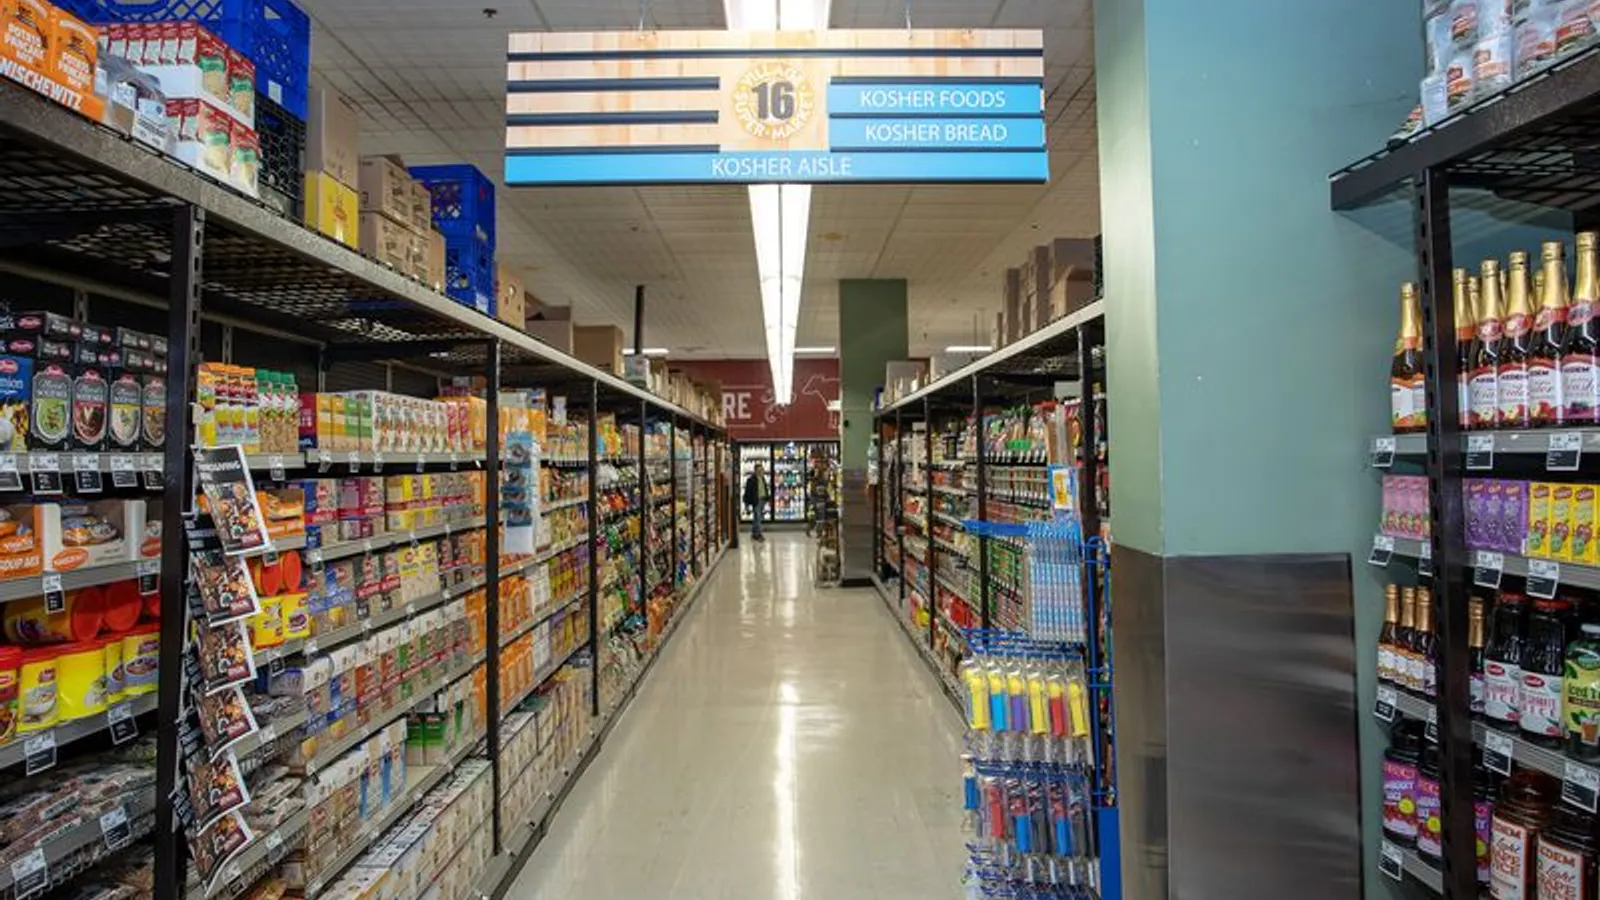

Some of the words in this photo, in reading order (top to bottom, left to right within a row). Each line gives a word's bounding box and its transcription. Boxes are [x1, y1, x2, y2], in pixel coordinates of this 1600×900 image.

[751, 82, 795, 119] 16
[860, 90, 935, 108] KOSHER
[939, 90, 1006, 108] FOODS
[865, 123, 940, 141] KOSHER
[945, 123, 1008, 141] BREAD
[711, 157, 792, 177] KOSHER
[797, 157, 853, 177] AISLE
